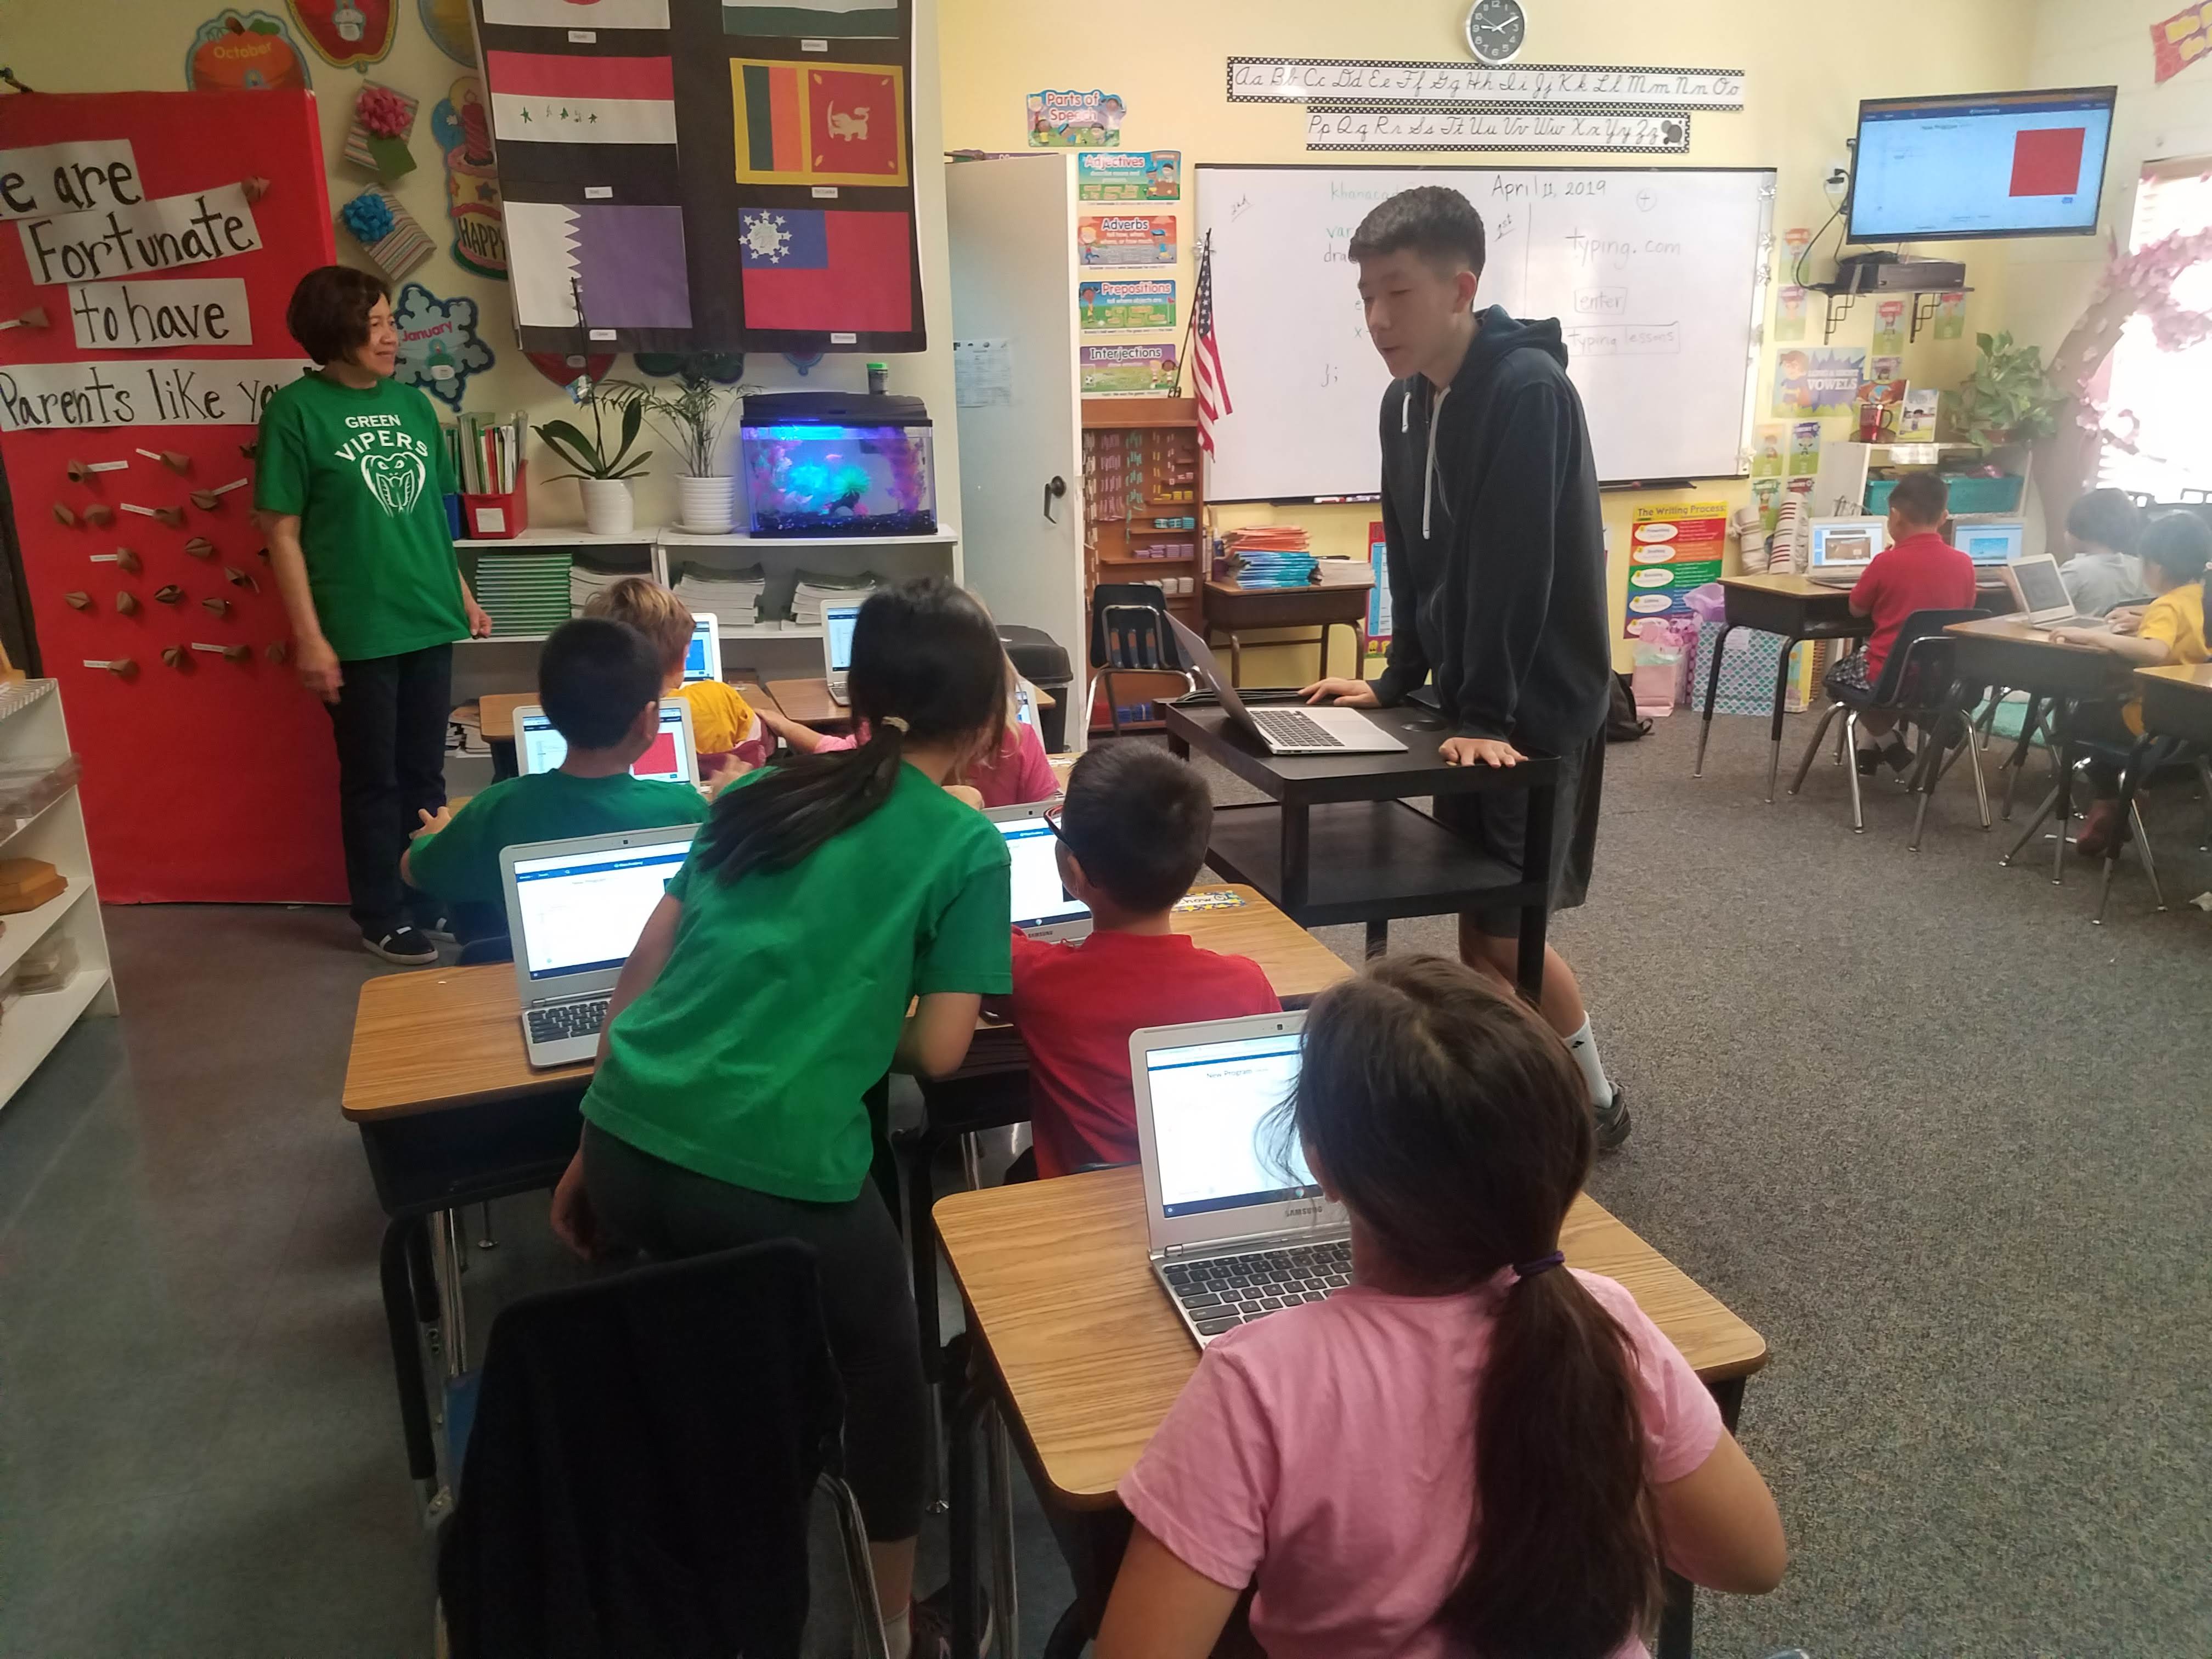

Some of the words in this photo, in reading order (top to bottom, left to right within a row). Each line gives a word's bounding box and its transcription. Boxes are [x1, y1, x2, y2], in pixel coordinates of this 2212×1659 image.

[1472, 24, 1480, 32] 9
[1513, 24, 1519, 32] 3
[1475, 36, 1482, 44] 8
[213, 41, 272, 60] October
[1235, 66, 1262, 86] Aa
[1270, 67, 1297, 86] Bb
[1304, 69, 1325, 87] Cc
[1332, 69, 1362, 88] Dd
[1369, 70, 1390, 88] Ee
[1397, 70, 1425, 97] Ff
[1430, 71, 1460, 97] Gg
[1466, 72, 1493, 91] Hh
[1499, 73, 1528, 92] Ii
[1533, 73, 1552, 99] Jj
[1559, 74, 1588, 92] Kk
[1593, 74, 1622, 93] Ll
[1627, 75, 1671, 94] Mm
[1676, 76, 1708, 95] Nn
[1712, 77, 1740, 96] Oo
[1047, 93, 1082, 105] Parts
[1085, 93, 1098, 105] of
[1050, 109, 1097, 122] Speech
[1308, 115, 1331, 142] Pp
[1336, 116, 1368, 142] Qq
[1374, 116, 1403, 134] Rr
[1410, 116, 1435, 134] Ss
[1441, 117, 1464, 134] Tt
[1470, 117, 1497, 135] Uu
[1504, 117, 1529, 135] Vv
[1533, 118, 1566, 135] Ww
[1572, 119, 1601, 136] Xx
[1605, 120, 1632, 144] Yy
[1636, 120, 1660, 145] Zz
[1085, 155, 1144, 170] Adjectives
[0, 172, 37, 213] e
[54, 162, 142, 209] are
[1331, 180, 1398, 201] khanacad
[1492, 174, 1538, 201] April
[1565, 180, 1606, 196] 2019
[1103, 219, 1148, 230] Adverbs
[1326, 226, 1355, 238] var
[29, 195, 255, 283] Fortunate
[1324, 242, 1350, 262] dra
[1103, 282, 1170, 295] Prepositions
[1580, 291, 1624, 311] enter
[74, 288, 118, 343] to
[122, 285, 229, 345] have
[403, 321, 453, 342] January
[1567, 329, 1616, 352] typing
[1625, 325, 1674, 345] lessons
[1090, 347, 1161, 360] Interjections
[1807, 378, 1858, 391] VOWELS
[0, 367, 136, 427] Parents
[237, 380, 279, 422] yo
[345, 414, 402, 428] GREEN
[334, 430, 428, 462] VIPERS
[1638, 508, 1654, 517] The
[1656, 506, 1688, 516] Writing
[1284, 1206, 1323, 1217] SAMSUNG
